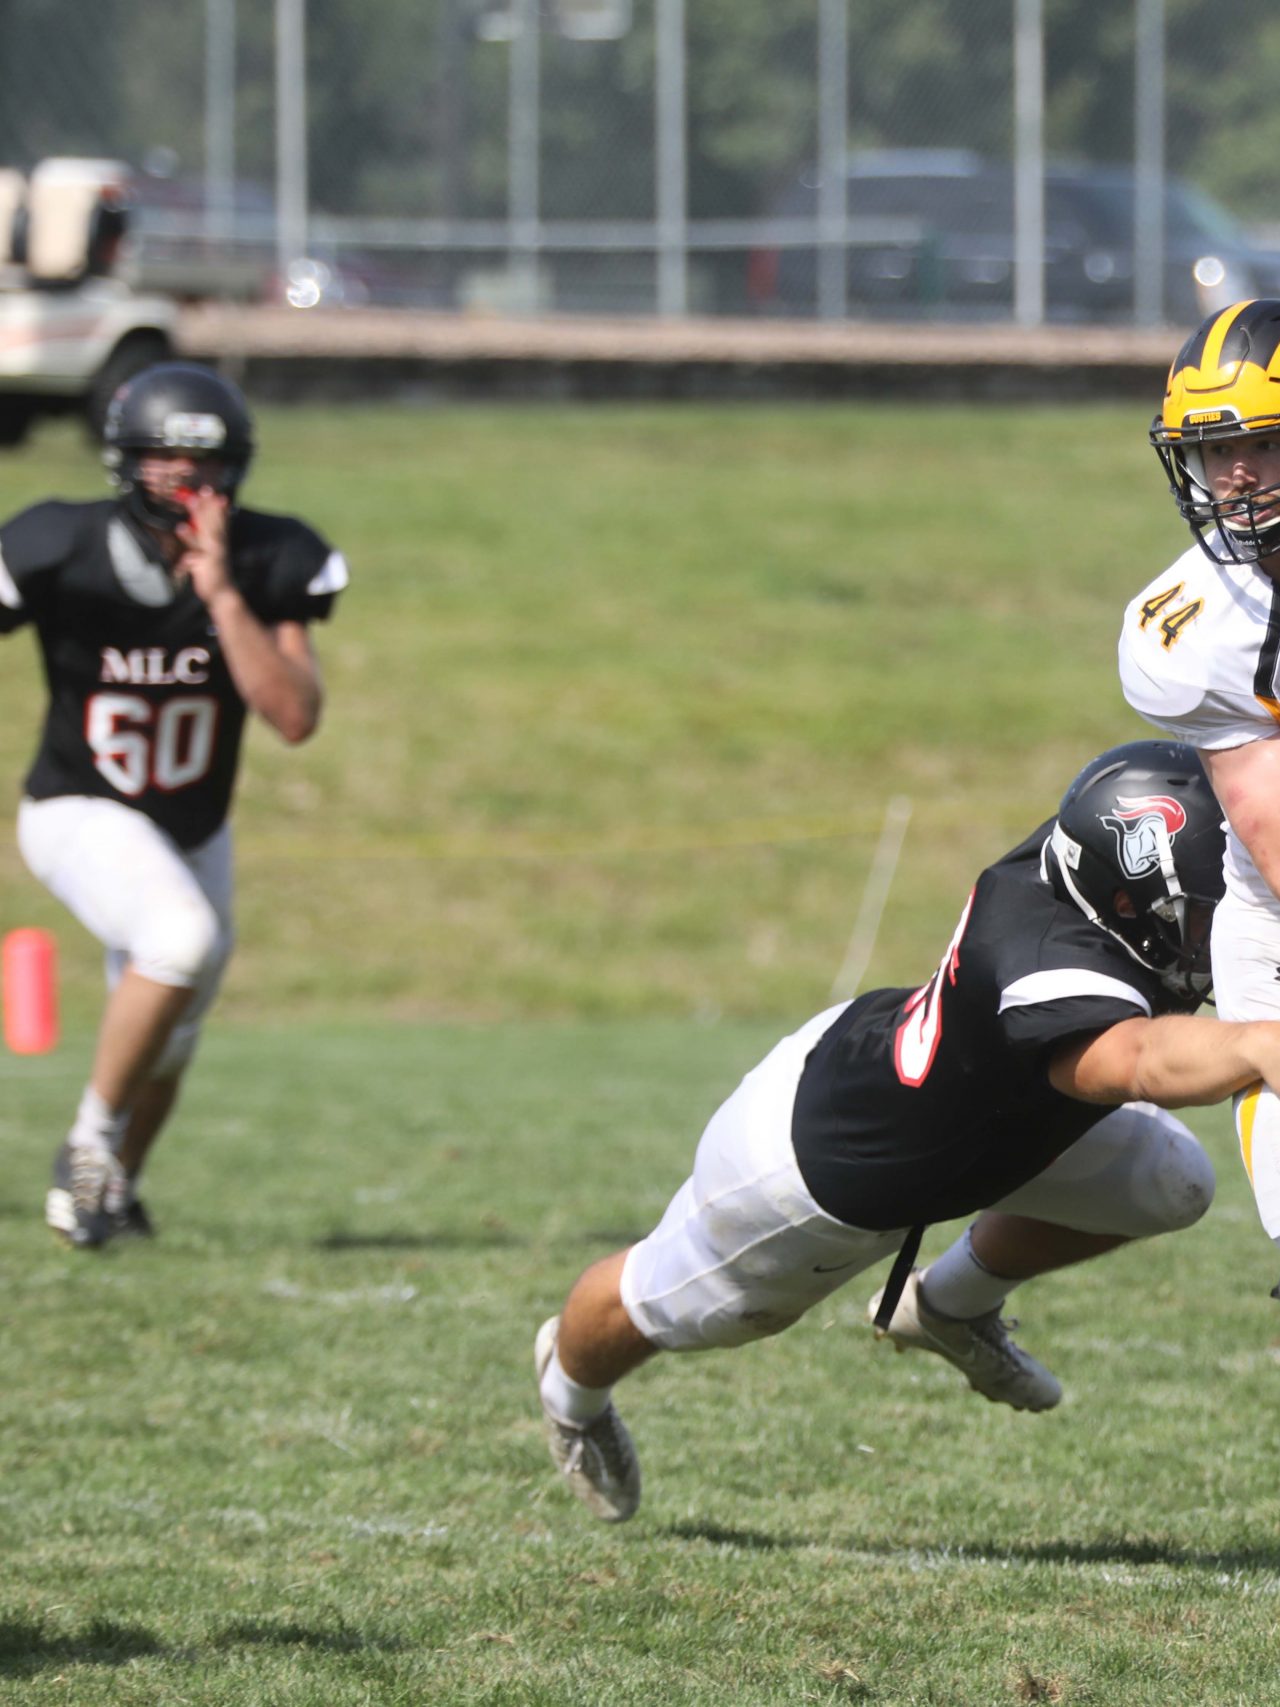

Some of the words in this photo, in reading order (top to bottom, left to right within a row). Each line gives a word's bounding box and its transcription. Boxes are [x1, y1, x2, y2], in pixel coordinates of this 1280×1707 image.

[1138, 581, 1205, 653] 44
[100, 647, 210, 685] MLC
[85, 692, 219, 796] 60
